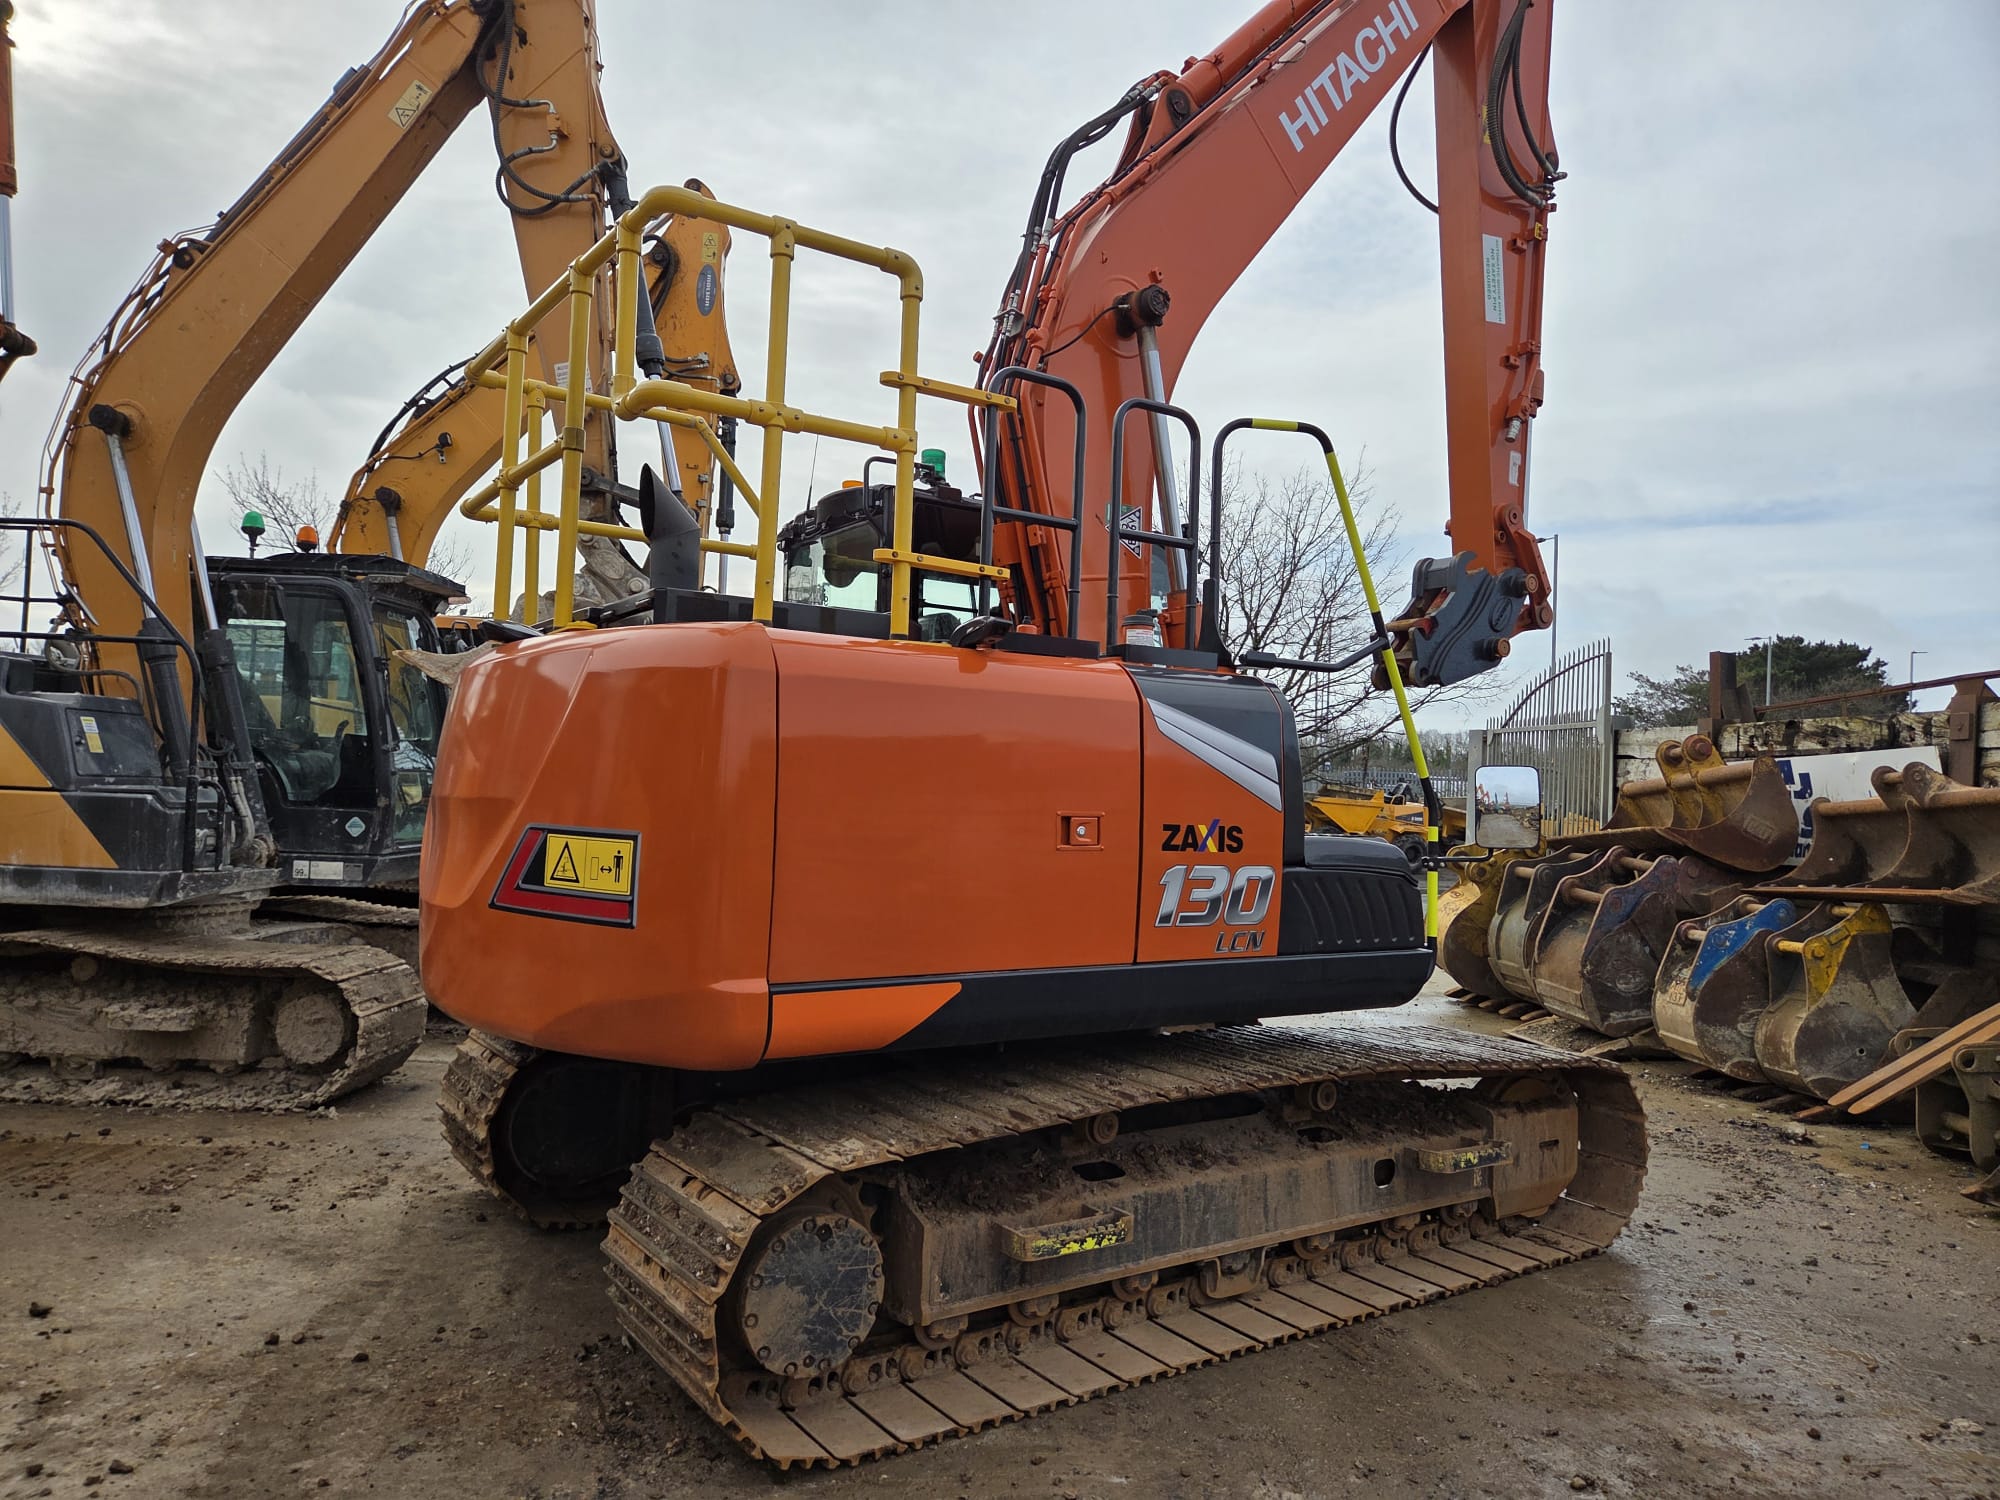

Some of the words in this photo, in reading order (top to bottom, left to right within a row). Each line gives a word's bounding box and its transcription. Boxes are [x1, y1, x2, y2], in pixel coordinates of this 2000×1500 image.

[1278, 0, 1419, 153] HITACHI
[1161, 819, 1244, 853] ZAXIS
[1154, 865, 1276, 928] 130
[1215, 930, 1265, 954] LCN
